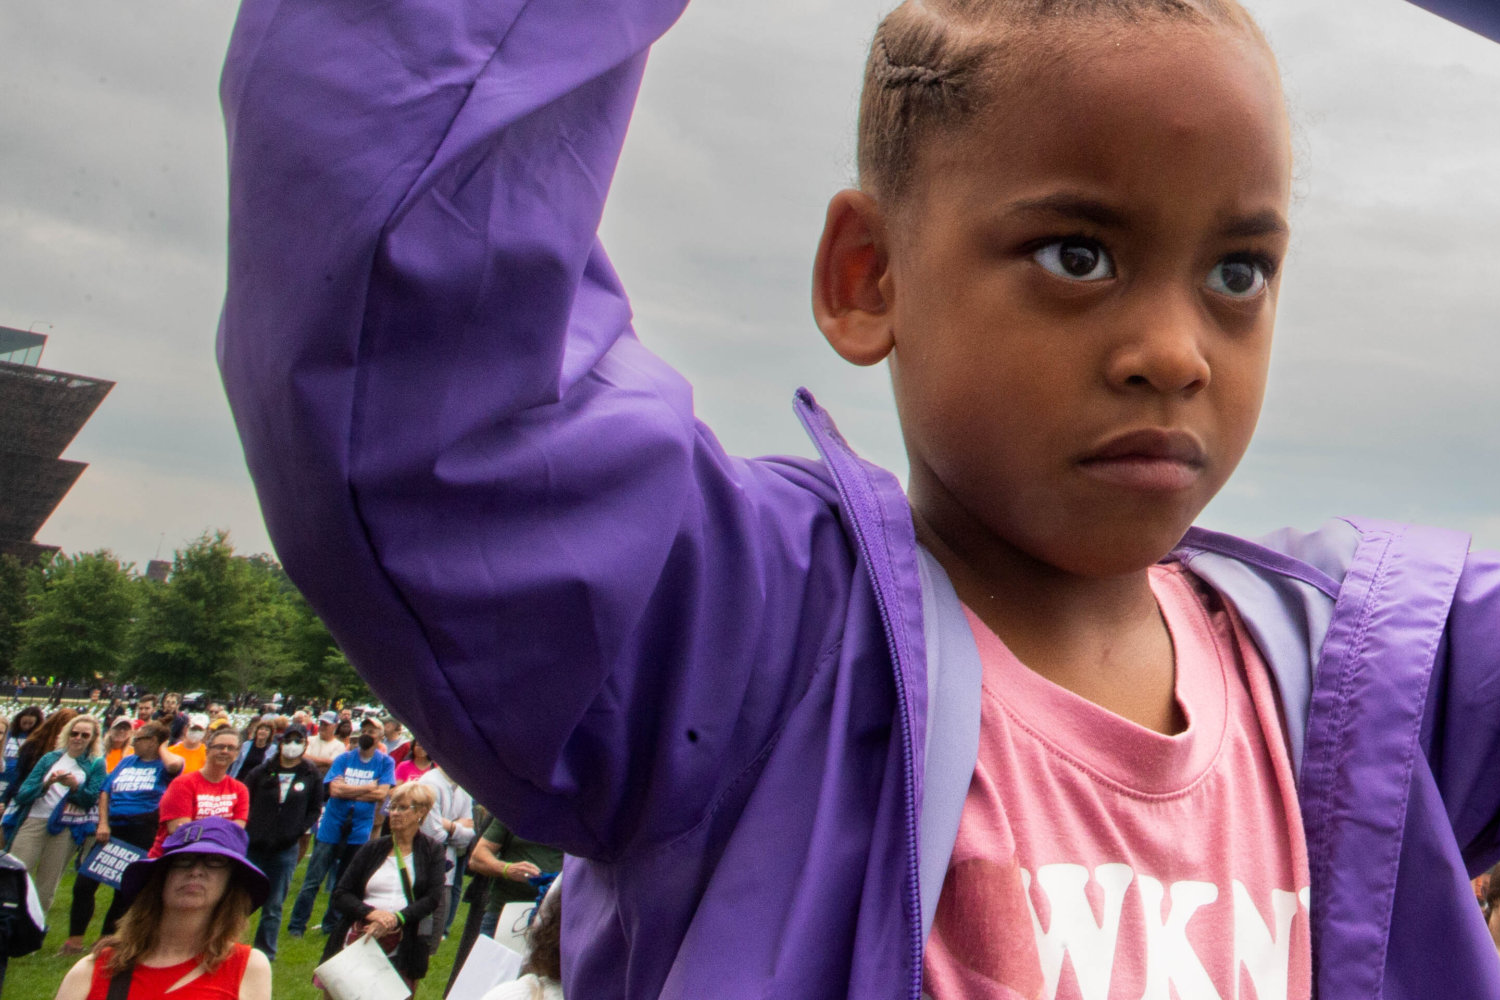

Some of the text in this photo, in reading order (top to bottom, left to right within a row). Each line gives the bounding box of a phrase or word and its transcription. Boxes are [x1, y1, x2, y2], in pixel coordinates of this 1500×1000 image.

[344, 767, 375, 779] MARCH
[95, 850, 119, 867] FOR
[102, 842, 140, 863] MARCH
[87, 860, 119, 881] LIVES
